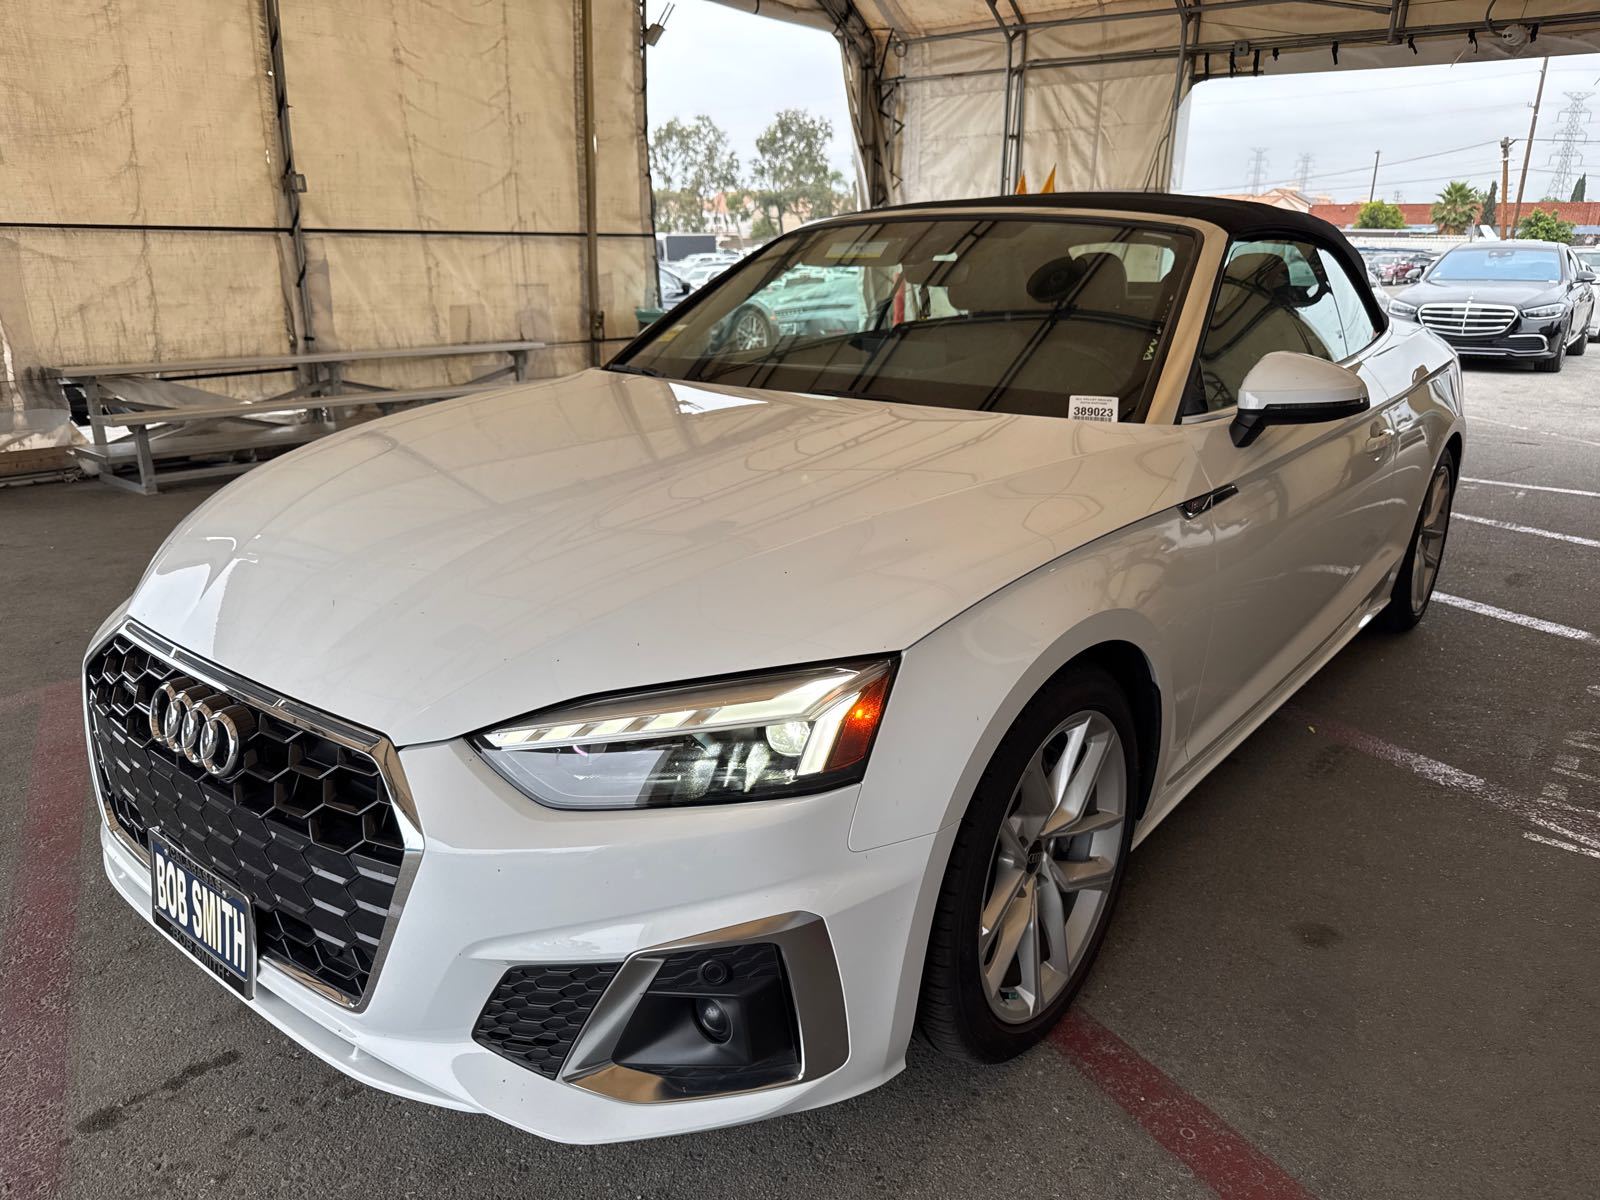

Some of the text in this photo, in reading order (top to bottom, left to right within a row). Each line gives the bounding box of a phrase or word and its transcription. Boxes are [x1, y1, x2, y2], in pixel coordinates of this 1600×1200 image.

[1073, 406, 1114, 417] 389023
[155, 852, 246, 973] BOB SMITH
[172, 927, 225, 980] BOB SMITH
